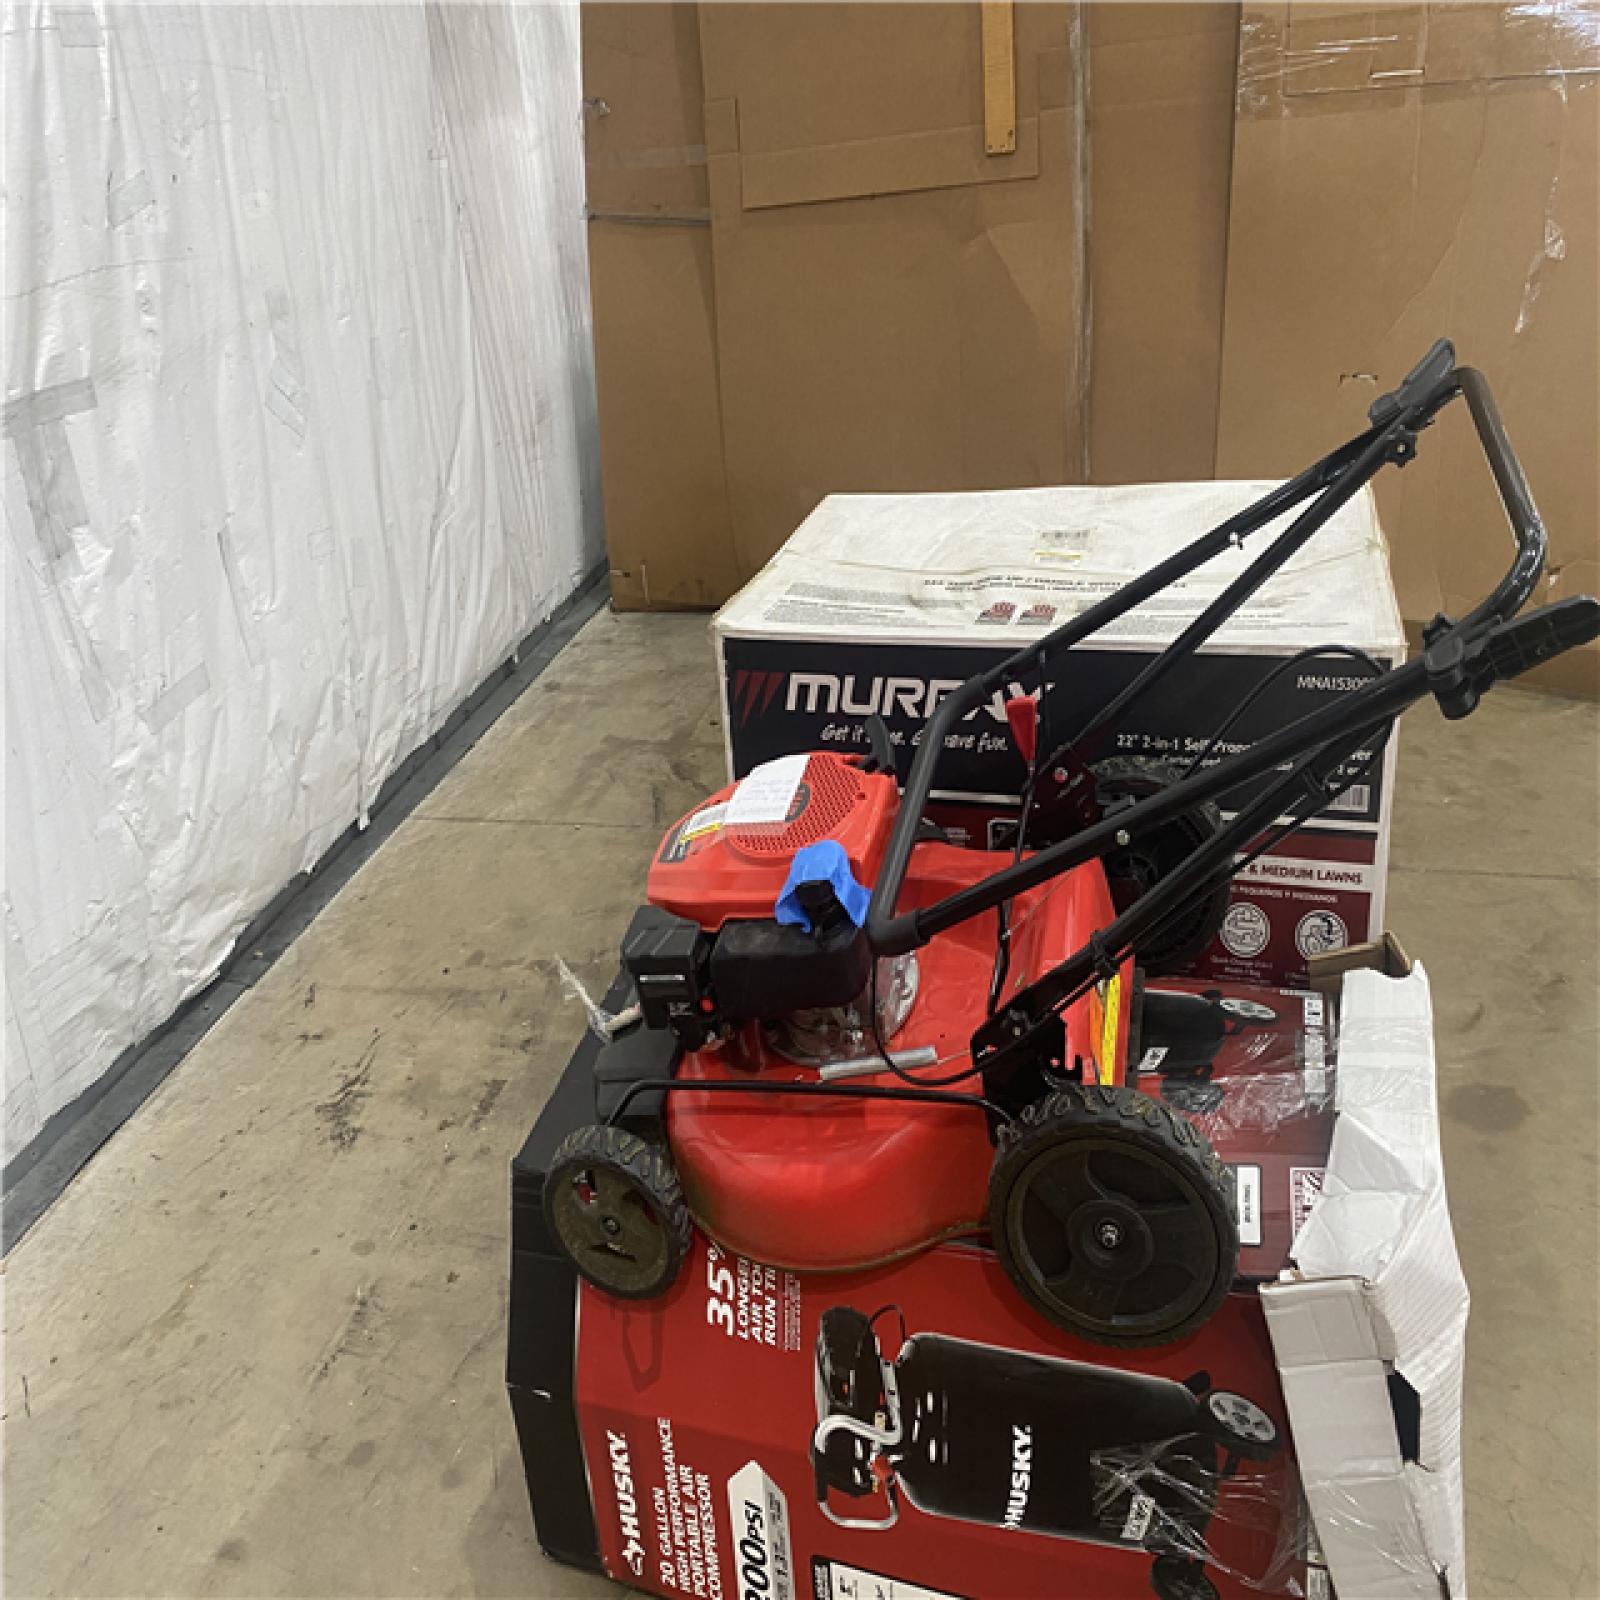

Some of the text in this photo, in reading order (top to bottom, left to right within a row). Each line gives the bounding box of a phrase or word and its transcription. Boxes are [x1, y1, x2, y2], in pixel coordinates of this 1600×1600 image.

[1261, 865, 1313, 880] MEDIUM
[1317, 869, 1363, 885] LAWNS
[751, 1302, 763, 1344] AIR
[764, 1295, 776, 1346] RUN
[606, 1429, 643, 1541] HUSKY
[656, 1416, 693, 1594] HIGH PERFORMANCE
[1004, 1424, 1033, 1521] HUSKY
[651, 1486, 677, 1589] 20 GALLON
[678, 1463, 708, 1599] PORTABLE AIR
[694, 1471, 724, 1600] COMPRESSOR
